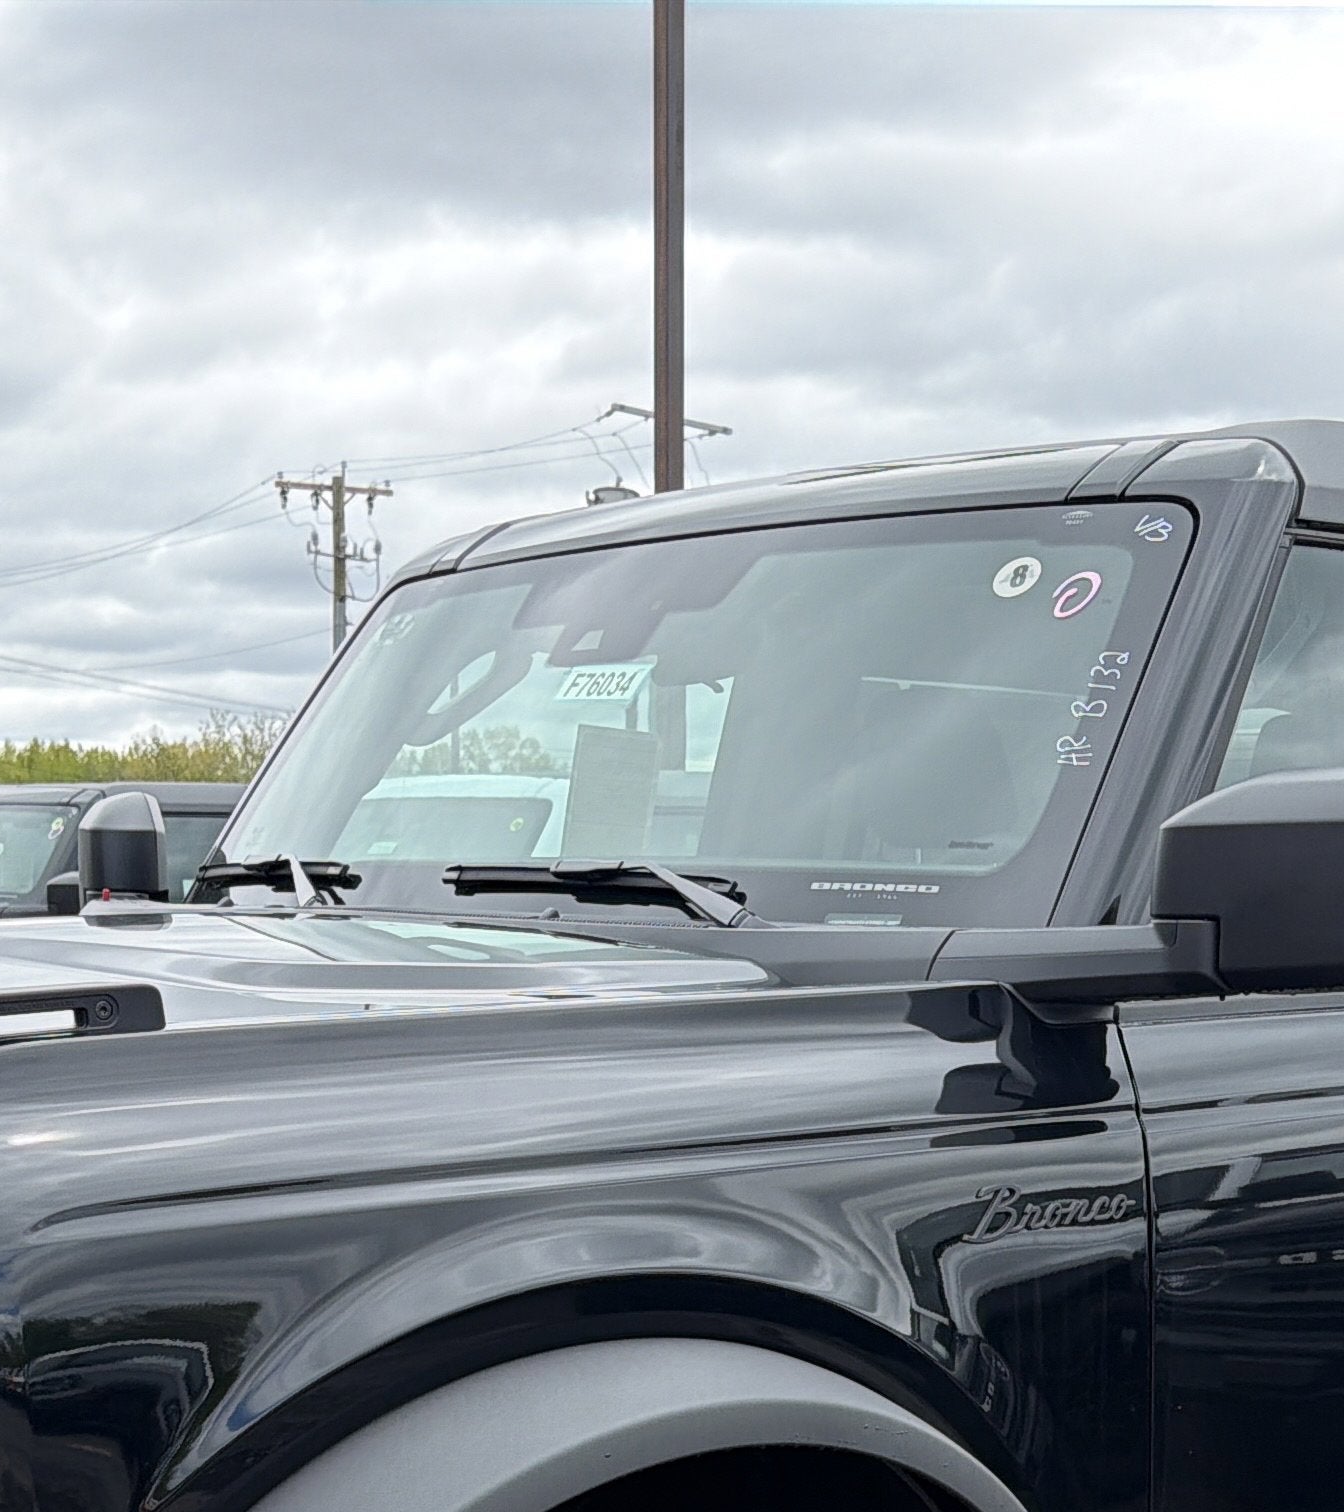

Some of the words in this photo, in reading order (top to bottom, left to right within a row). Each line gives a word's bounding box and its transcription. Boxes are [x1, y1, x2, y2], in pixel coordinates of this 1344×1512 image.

[1009, 564, 1029, 588] 8
[1088, 651, 1130, 690] 132
[562, 671, 640, 697] F76034
[810, 882, 940, 893] BRONCO
[961, 1184, 1137, 1244] Bronco
